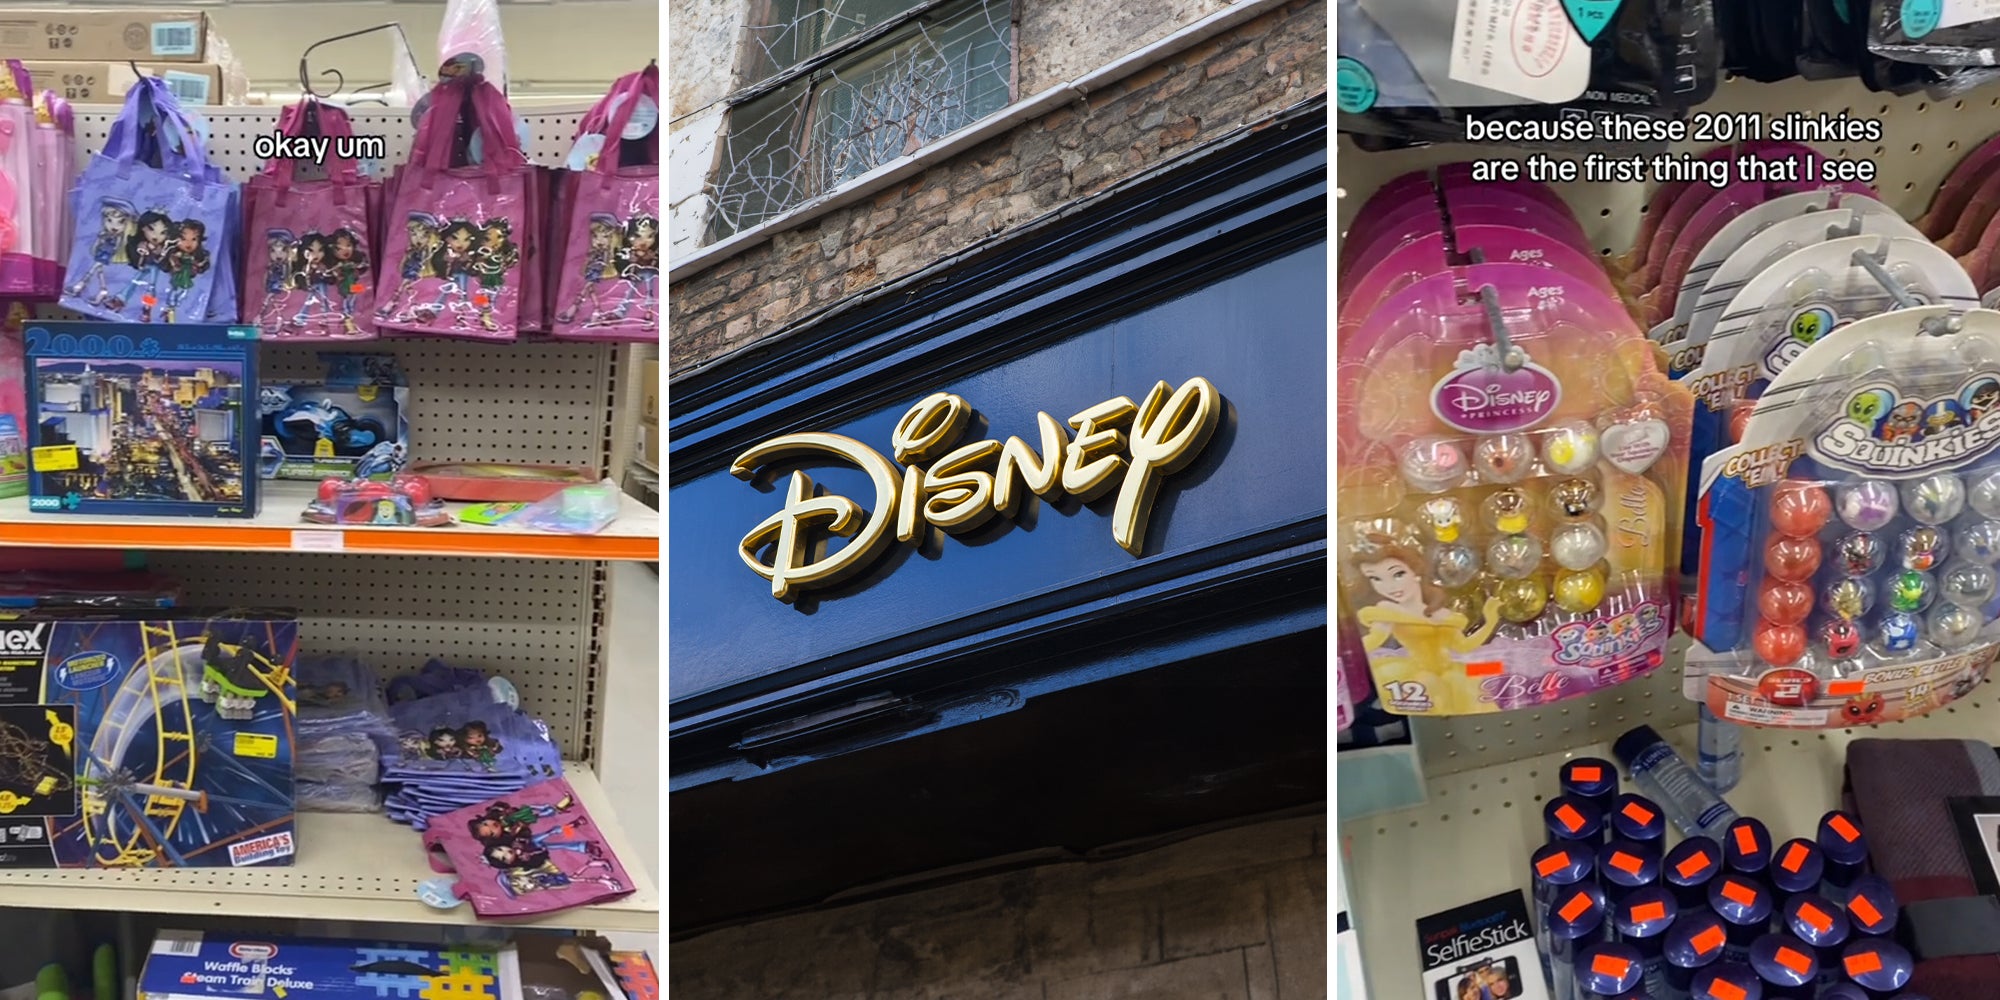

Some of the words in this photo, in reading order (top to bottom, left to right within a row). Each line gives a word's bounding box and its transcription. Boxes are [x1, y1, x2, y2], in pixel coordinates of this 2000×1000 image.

[1509, 248, 1544, 261] Ages
[1527, 285, 1565, 299] Ages
[25, 327, 134, 358] 2000
[1691, 365, 1758, 398] COLLECT
[1443, 383, 1551, 412] Disney
[1469, 406, 1533, 420] PRINCESS
[1725, 440, 1802, 478] COLLECT
[730, 376, 1220, 599] Disney
[31, 498, 61, 508] 2000
[1618, 485, 1649, 548] Belle
[1479, 671, 1569, 702] Belle
[1864, 666, 1915, 684] BONUS
[1384, 681, 1428, 702] 12
[1773, 683, 1802, 699] 2
[232, 833, 291, 858] AMERICA'S
[1427, 919, 1529, 967] SelfieStick
[204, 960, 248, 974] Waffle
[251, 962, 294, 976] Blocks
[266, 976, 314, 990] Deluxe
